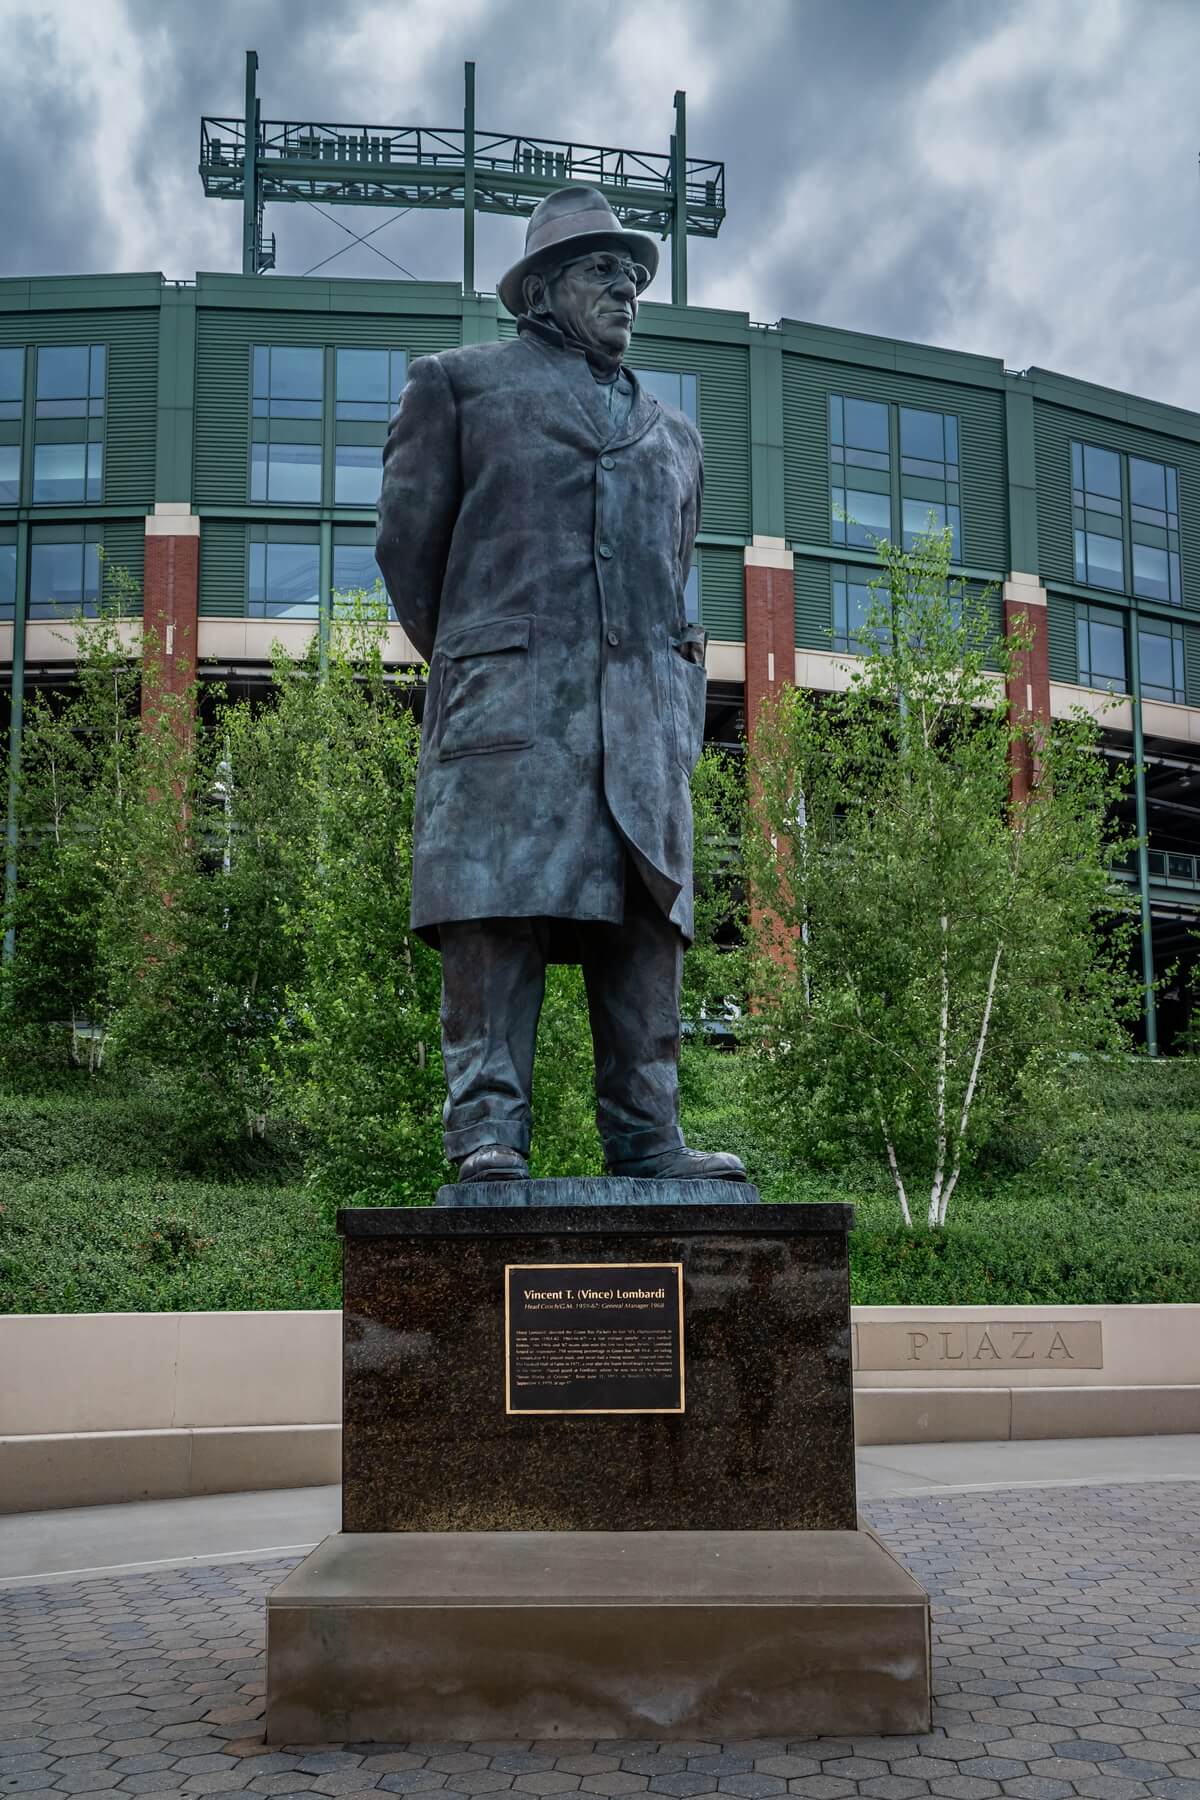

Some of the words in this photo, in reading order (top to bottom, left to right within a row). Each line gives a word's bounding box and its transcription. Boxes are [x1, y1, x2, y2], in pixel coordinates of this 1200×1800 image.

[524, 1289, 562, 1300] Vincent
[566, 1289, 574, 1300] T.
[578, 1289, 614, 1301] (Vince)
[617, 1288, 665, 1299] Lombardi
[904, 1331, 1074, 1361] PLAZA
